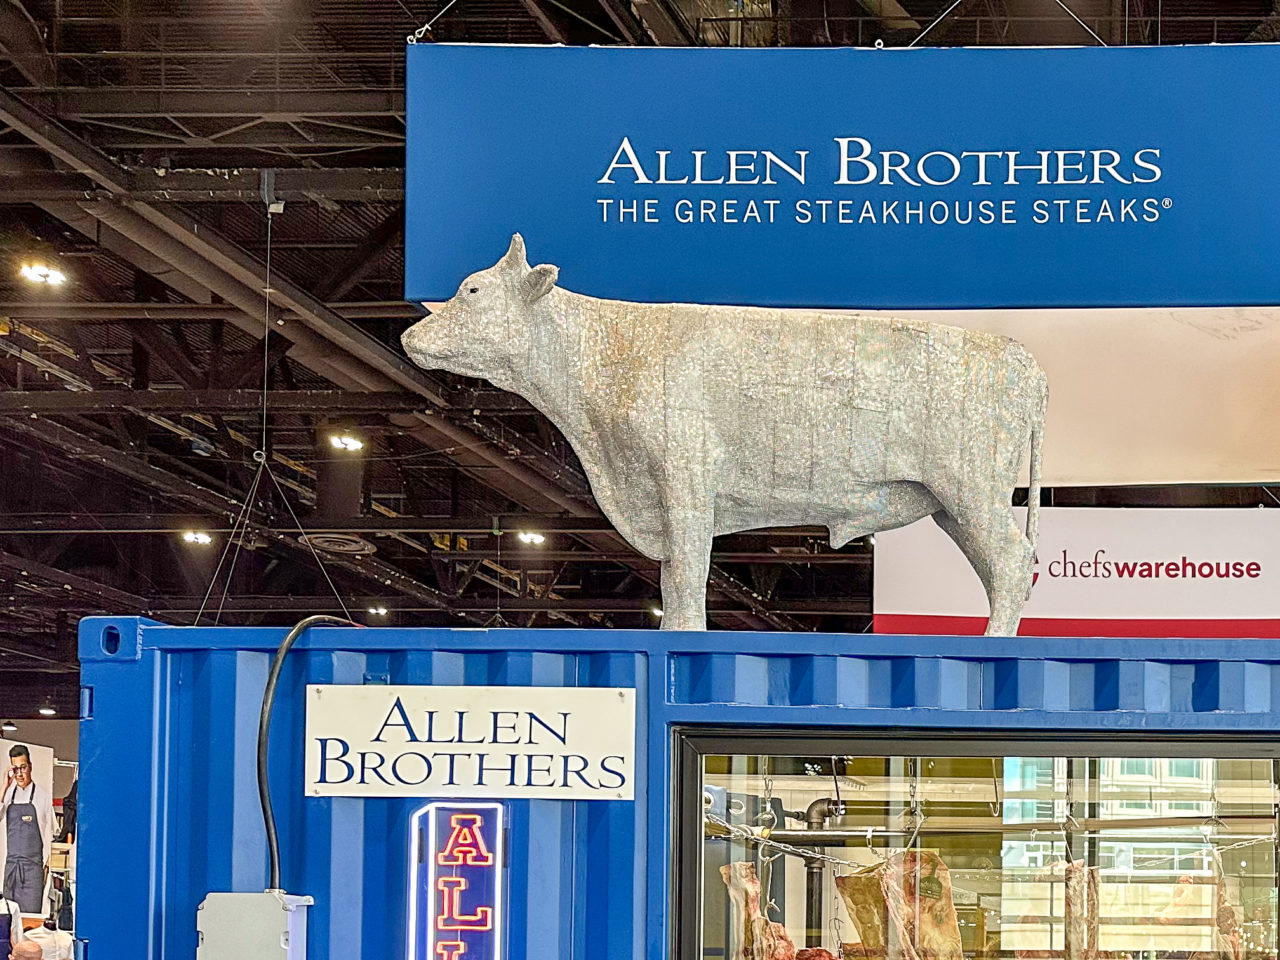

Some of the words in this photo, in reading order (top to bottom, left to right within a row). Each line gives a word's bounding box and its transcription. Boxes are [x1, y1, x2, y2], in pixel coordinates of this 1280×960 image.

[597, 135, 808, 187] ALLEN
[833, 136, 1163, 188] BROTHERS
[597, 199, 660, 224] THE
[675, 199, 779, 224] GREAT
[795, 199, 1020, 224] STEAKHOUSE
[1048, 550, 1262, 579] chefswarehouse
[370, 696, 571, 746] ALLEN
[313, 737, 627, 790] BROTHERS
